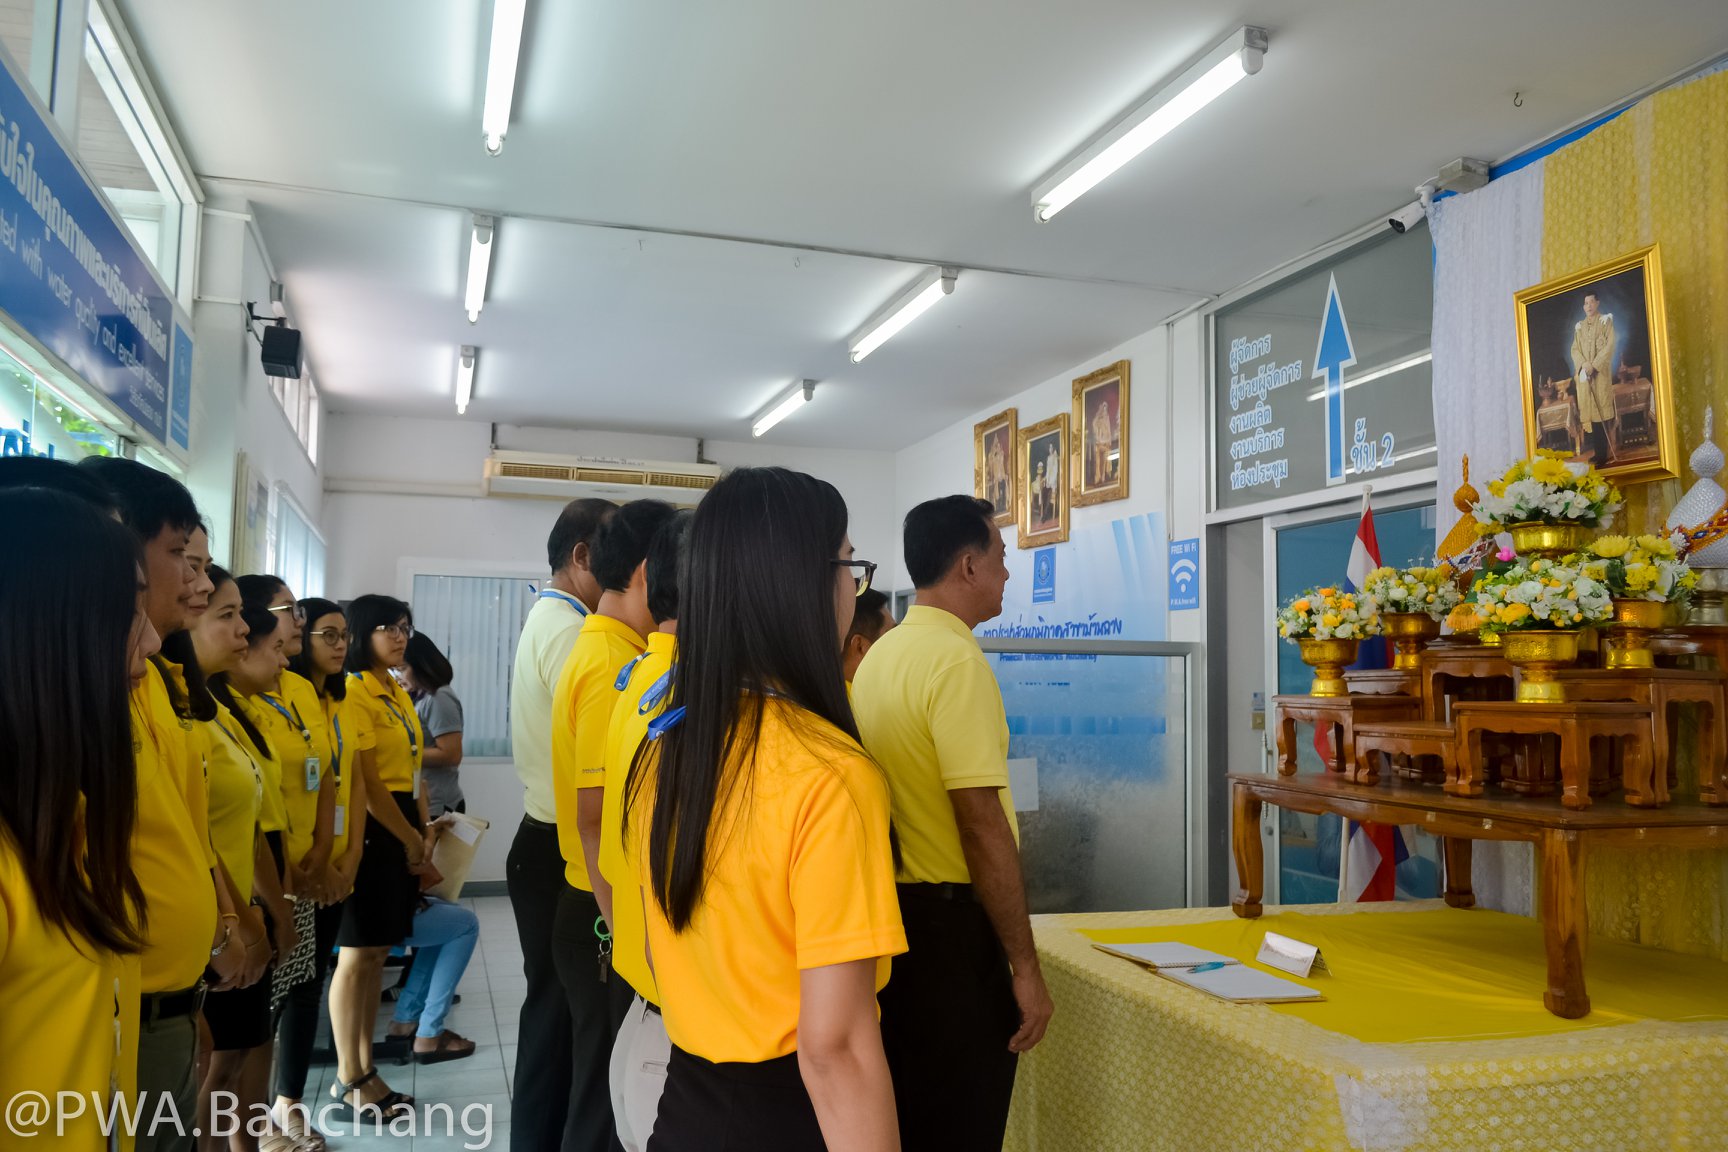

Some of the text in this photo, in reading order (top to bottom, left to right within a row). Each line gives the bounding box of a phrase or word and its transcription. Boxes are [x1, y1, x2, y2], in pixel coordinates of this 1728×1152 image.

[21, 238, 43, 281] with
[47, 265, 73, 309] water
[75, 297, 100, 346] quality
[103, 323, 117, 354] and
[1229, 334, 1272, 374] ผู้จัดการ
[1229, 360, 1302, 411] ผู้ช่วยผู้จัดการ
[1229, 400, 1272, 434] งานผลิต
[1230, 427, 1285, 460] งานบริการ
[1351, 417, 1395, 475] ชั้น 2
[1231, 459, 1288, 490] ห้องประชุม
[1170, 544, 1183, 555] FREE
